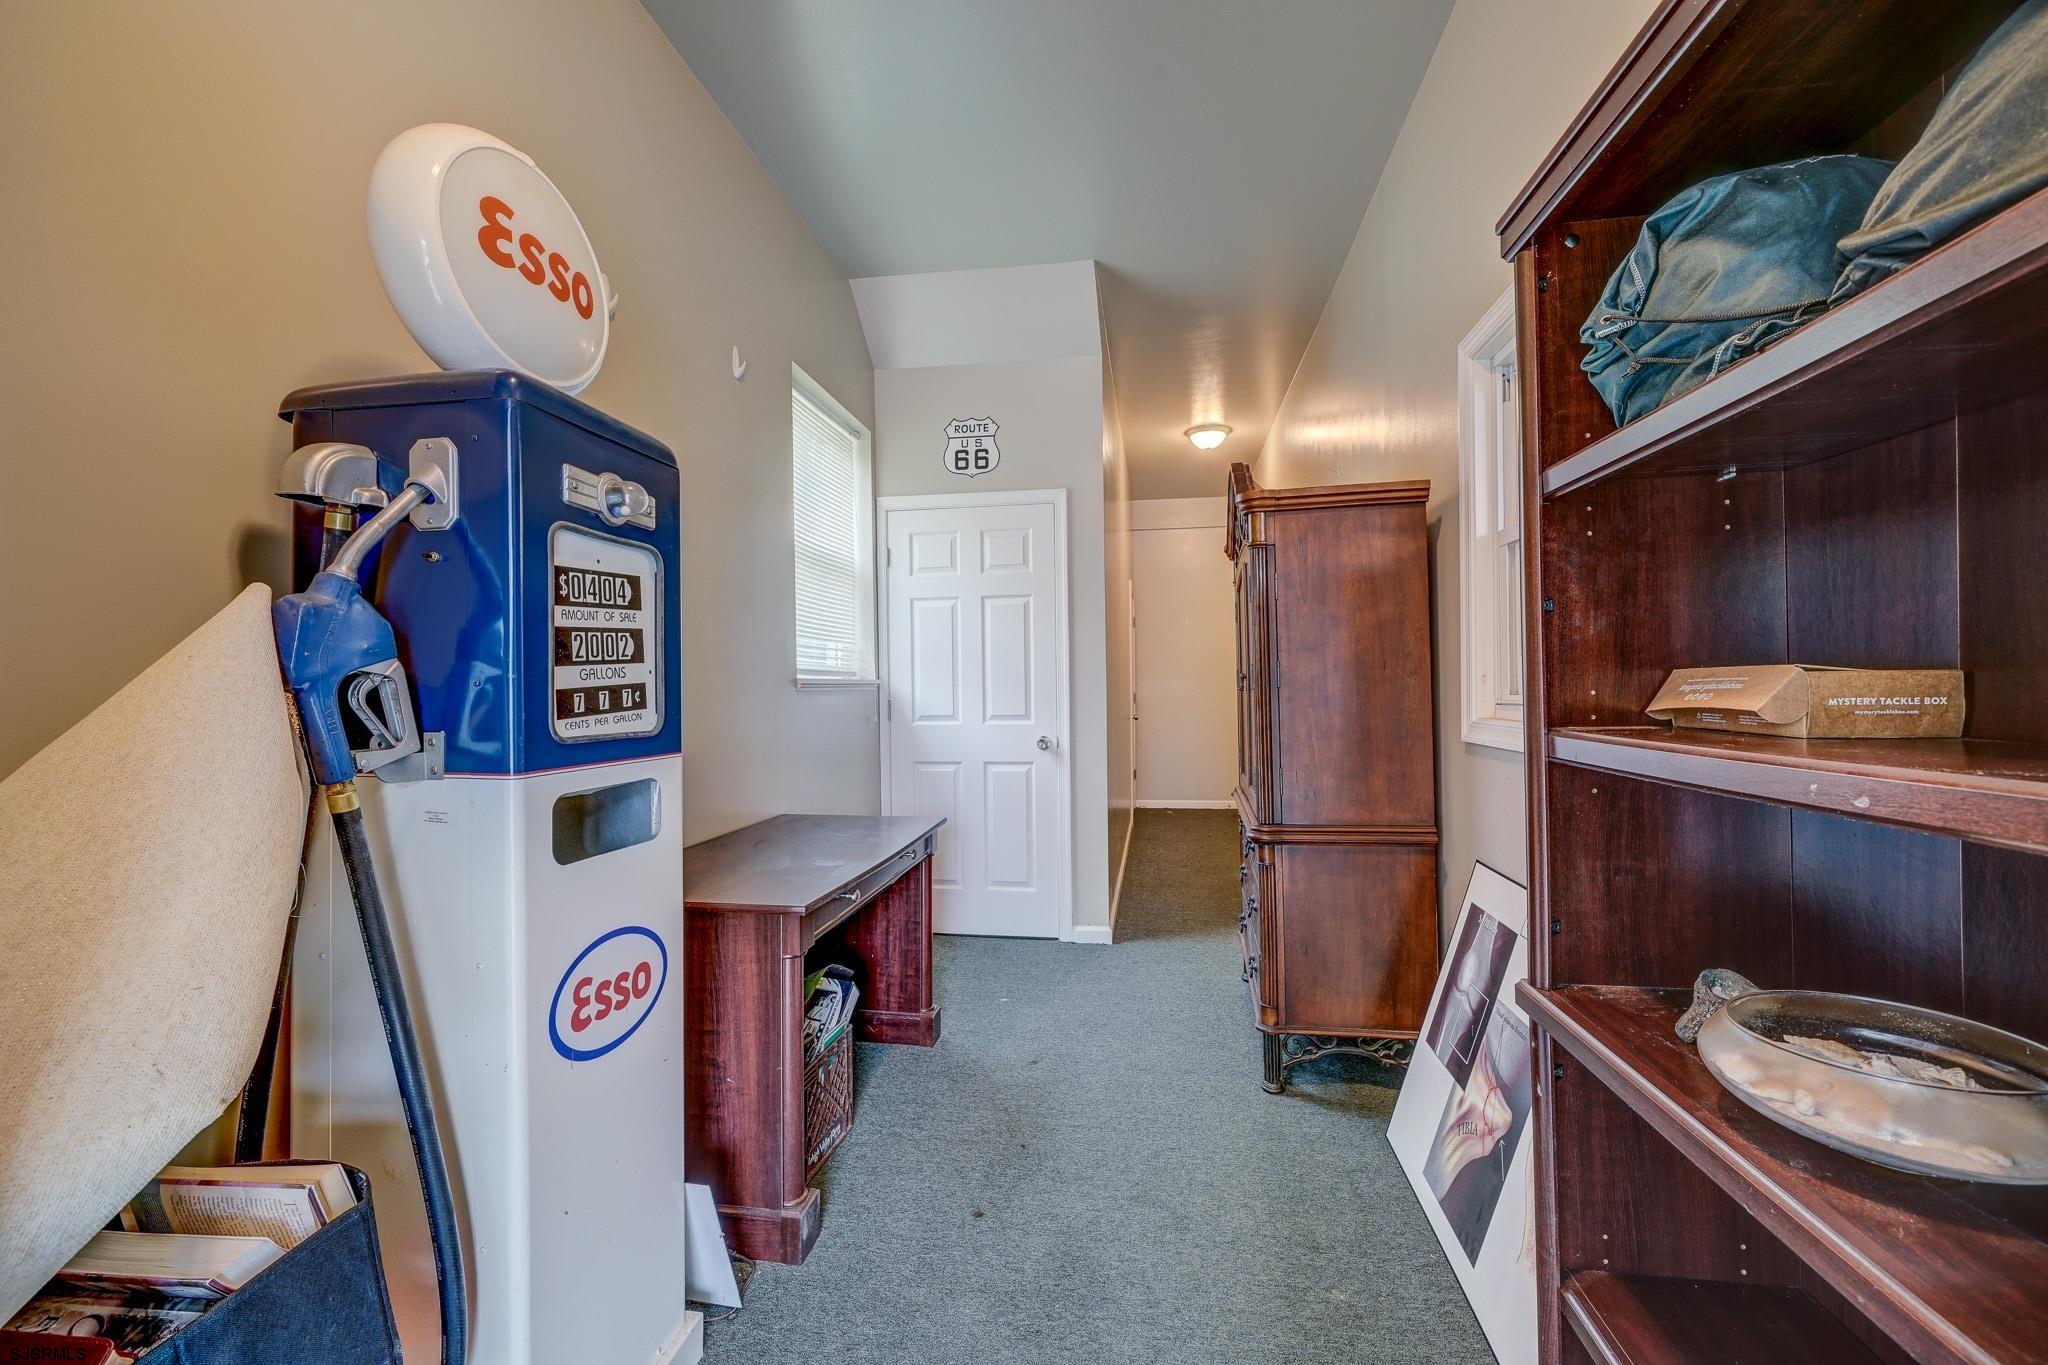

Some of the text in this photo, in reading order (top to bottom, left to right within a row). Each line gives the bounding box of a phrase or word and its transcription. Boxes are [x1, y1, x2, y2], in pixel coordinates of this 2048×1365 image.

[954, 423, 989, 433] ROUTE
[954, 448, 989, 470] 66
[561, 609, 637, 623] AMOUNT OF SALE
[573, 633, 629, 659] 2002
[580, 667, 627, 680] GALLONS
[1828, 696, 1948, 706] MYSTERY TACKLE BOX
[564, 712, 642, 731] CENTS PER GALLON
